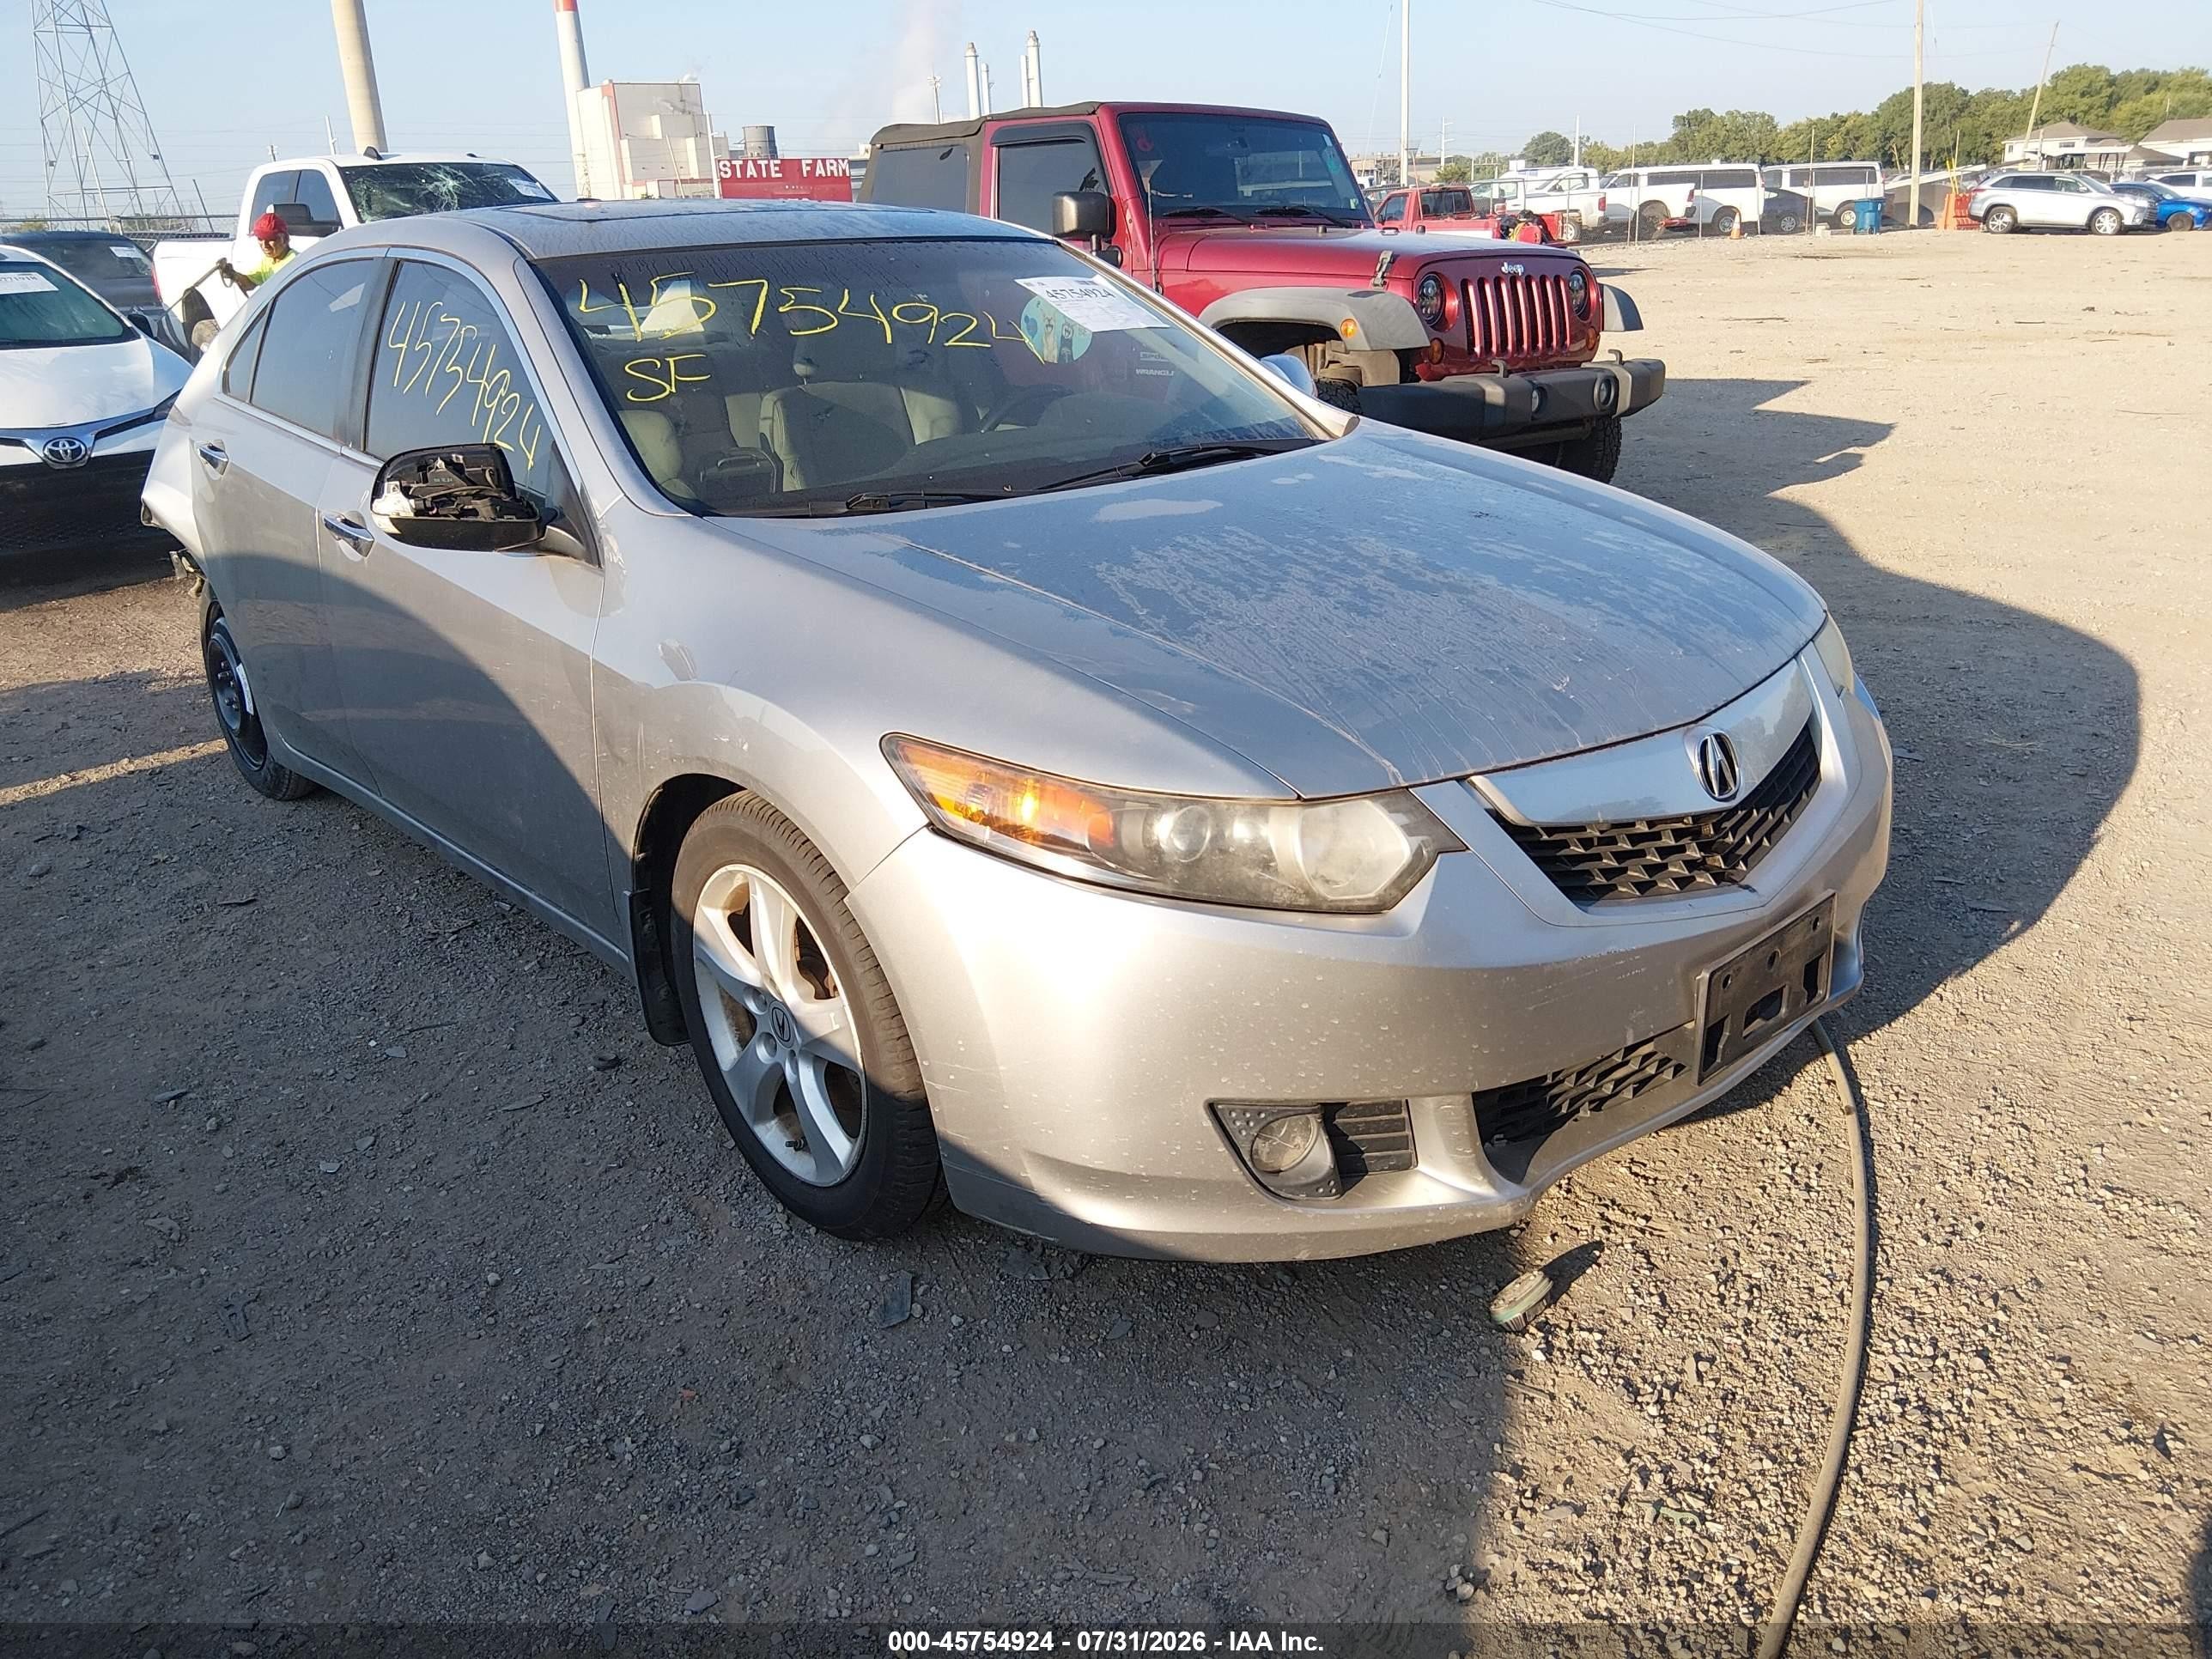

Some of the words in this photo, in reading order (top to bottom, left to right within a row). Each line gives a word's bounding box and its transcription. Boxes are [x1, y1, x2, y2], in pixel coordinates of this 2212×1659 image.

[719, 159, 783, 179] STATE
[801, 159, 850, 178] FARM
[1501, 261, 1524, 276] Jeep
[1045, 288, 1116, 300] 45754924
[579, 271, 1046, 365] 45754924
[388, 301, 541, 471] 45754924
[624, 354, 711, 402] SF
